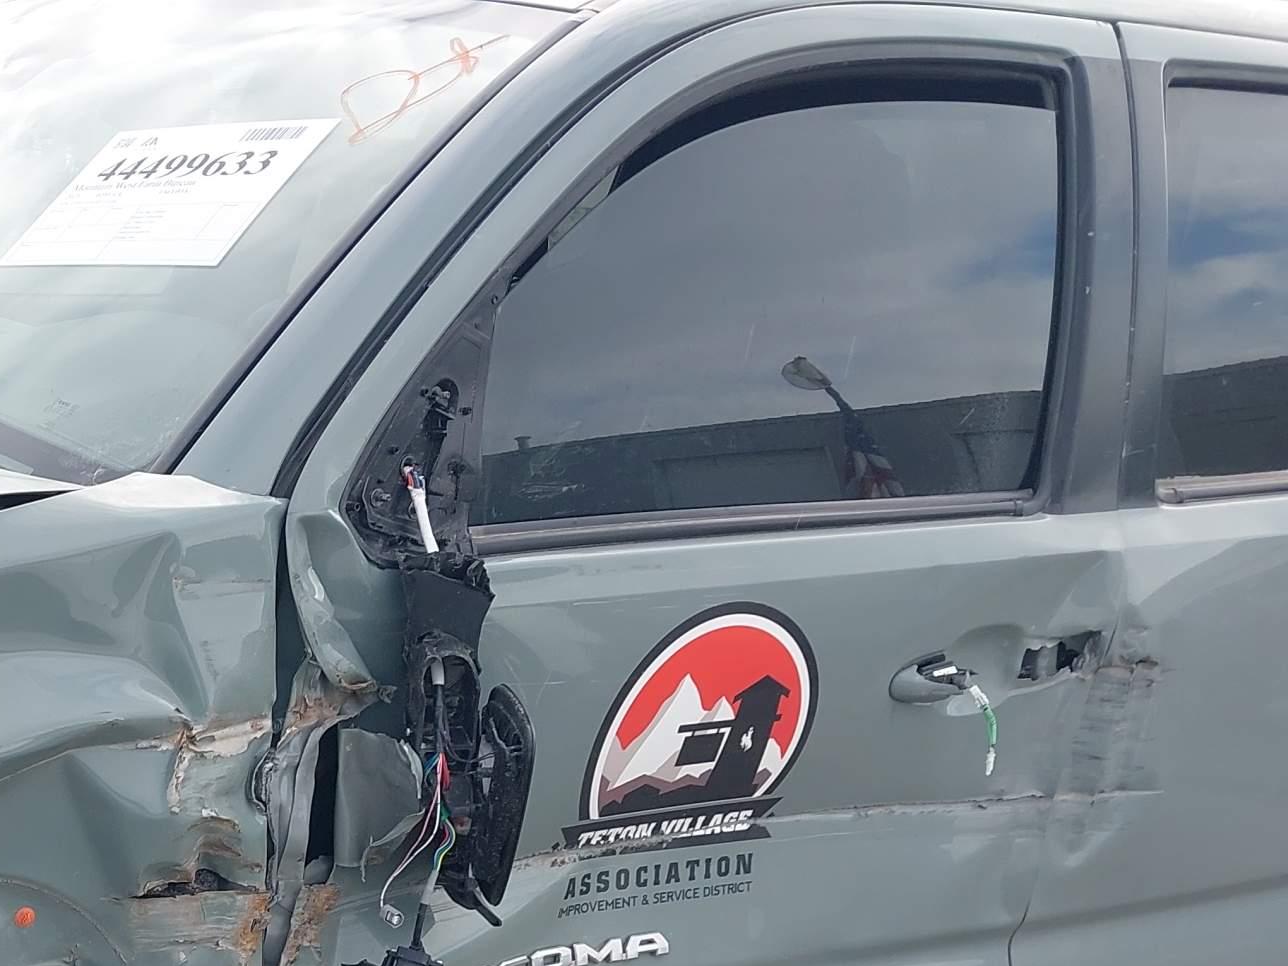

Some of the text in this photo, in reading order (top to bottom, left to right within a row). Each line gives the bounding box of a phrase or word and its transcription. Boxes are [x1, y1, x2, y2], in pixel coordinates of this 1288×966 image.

[97, 150, 279, 181] 44499633
[578, 809, 754, 849] TETON VILLAGE
[564, 852, 754, 900] ASSOCIATION
[557, 881, 753, 919] IMPROVEMENT & SERVICE DISTRICT
